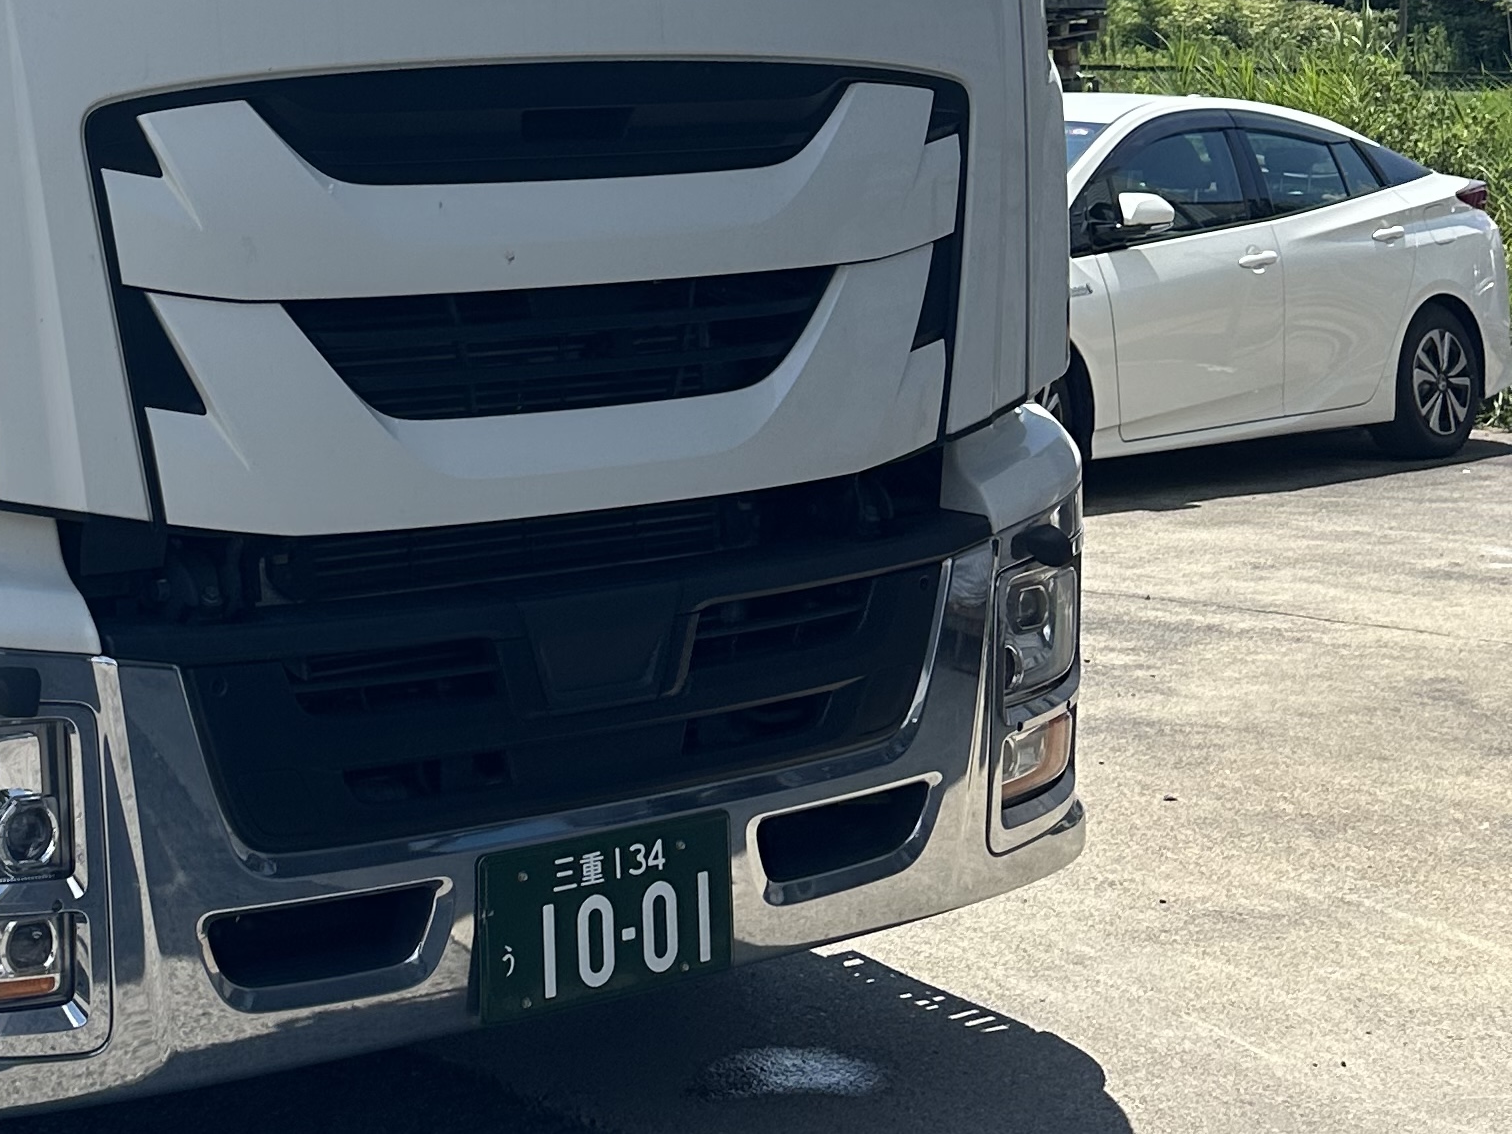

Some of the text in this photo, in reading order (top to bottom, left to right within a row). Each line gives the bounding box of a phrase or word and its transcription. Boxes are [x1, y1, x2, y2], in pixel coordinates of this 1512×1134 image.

[553, 838, 666, 892] 三重 134
[502, 870, 712, 999] う 10-01
